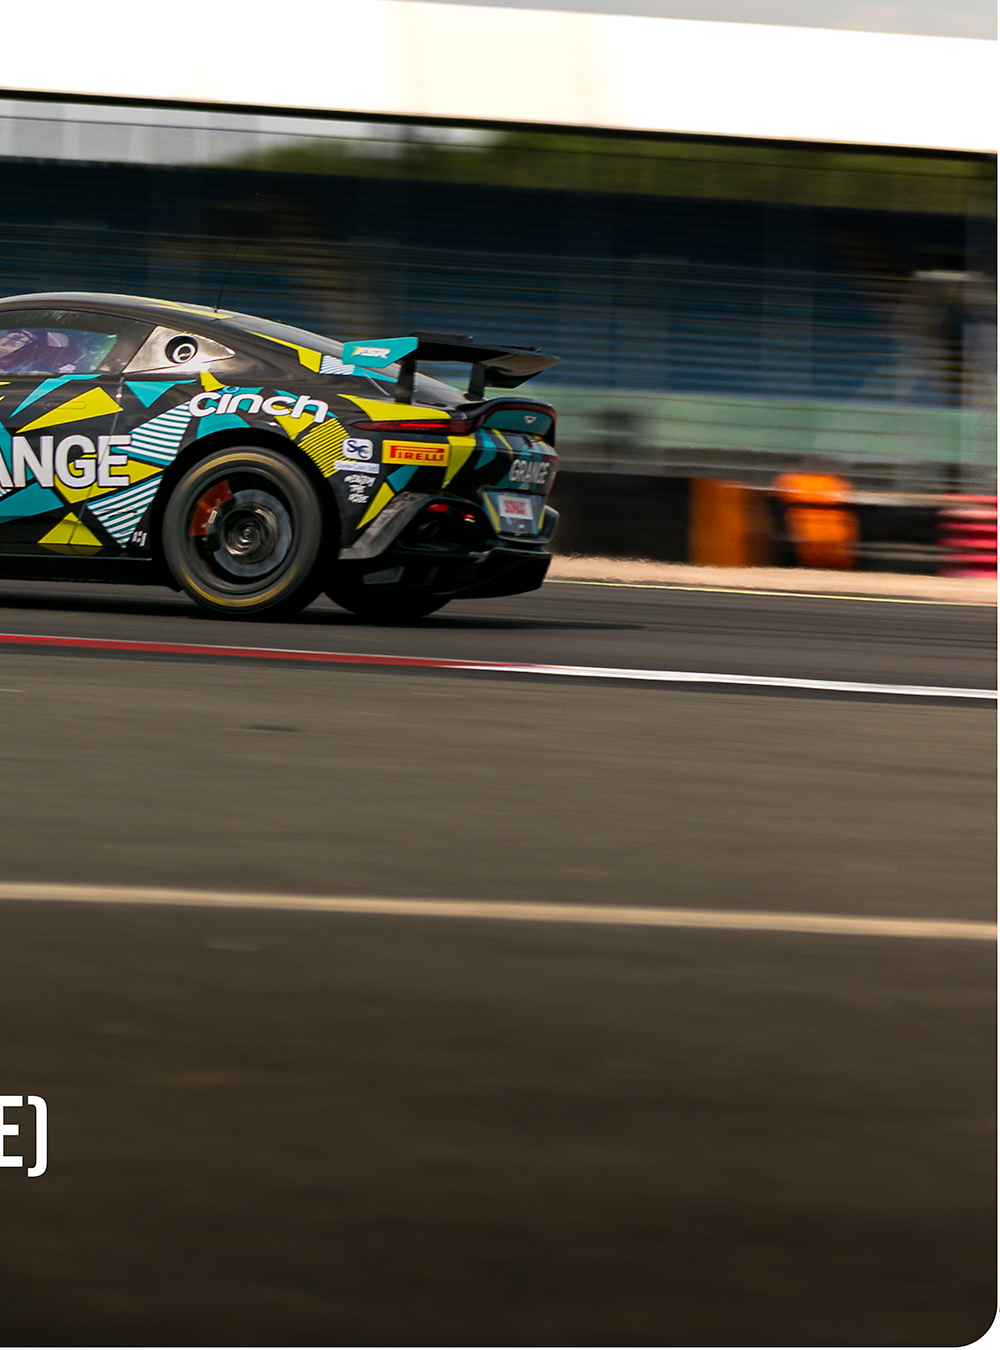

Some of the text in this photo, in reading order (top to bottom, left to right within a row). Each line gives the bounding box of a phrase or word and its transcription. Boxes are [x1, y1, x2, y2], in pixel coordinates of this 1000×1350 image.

[188, 386, 329, 423] cinch
[390, 445, 445, 462] PIRELLI
[508, 458, 551, 485] GRANGE
